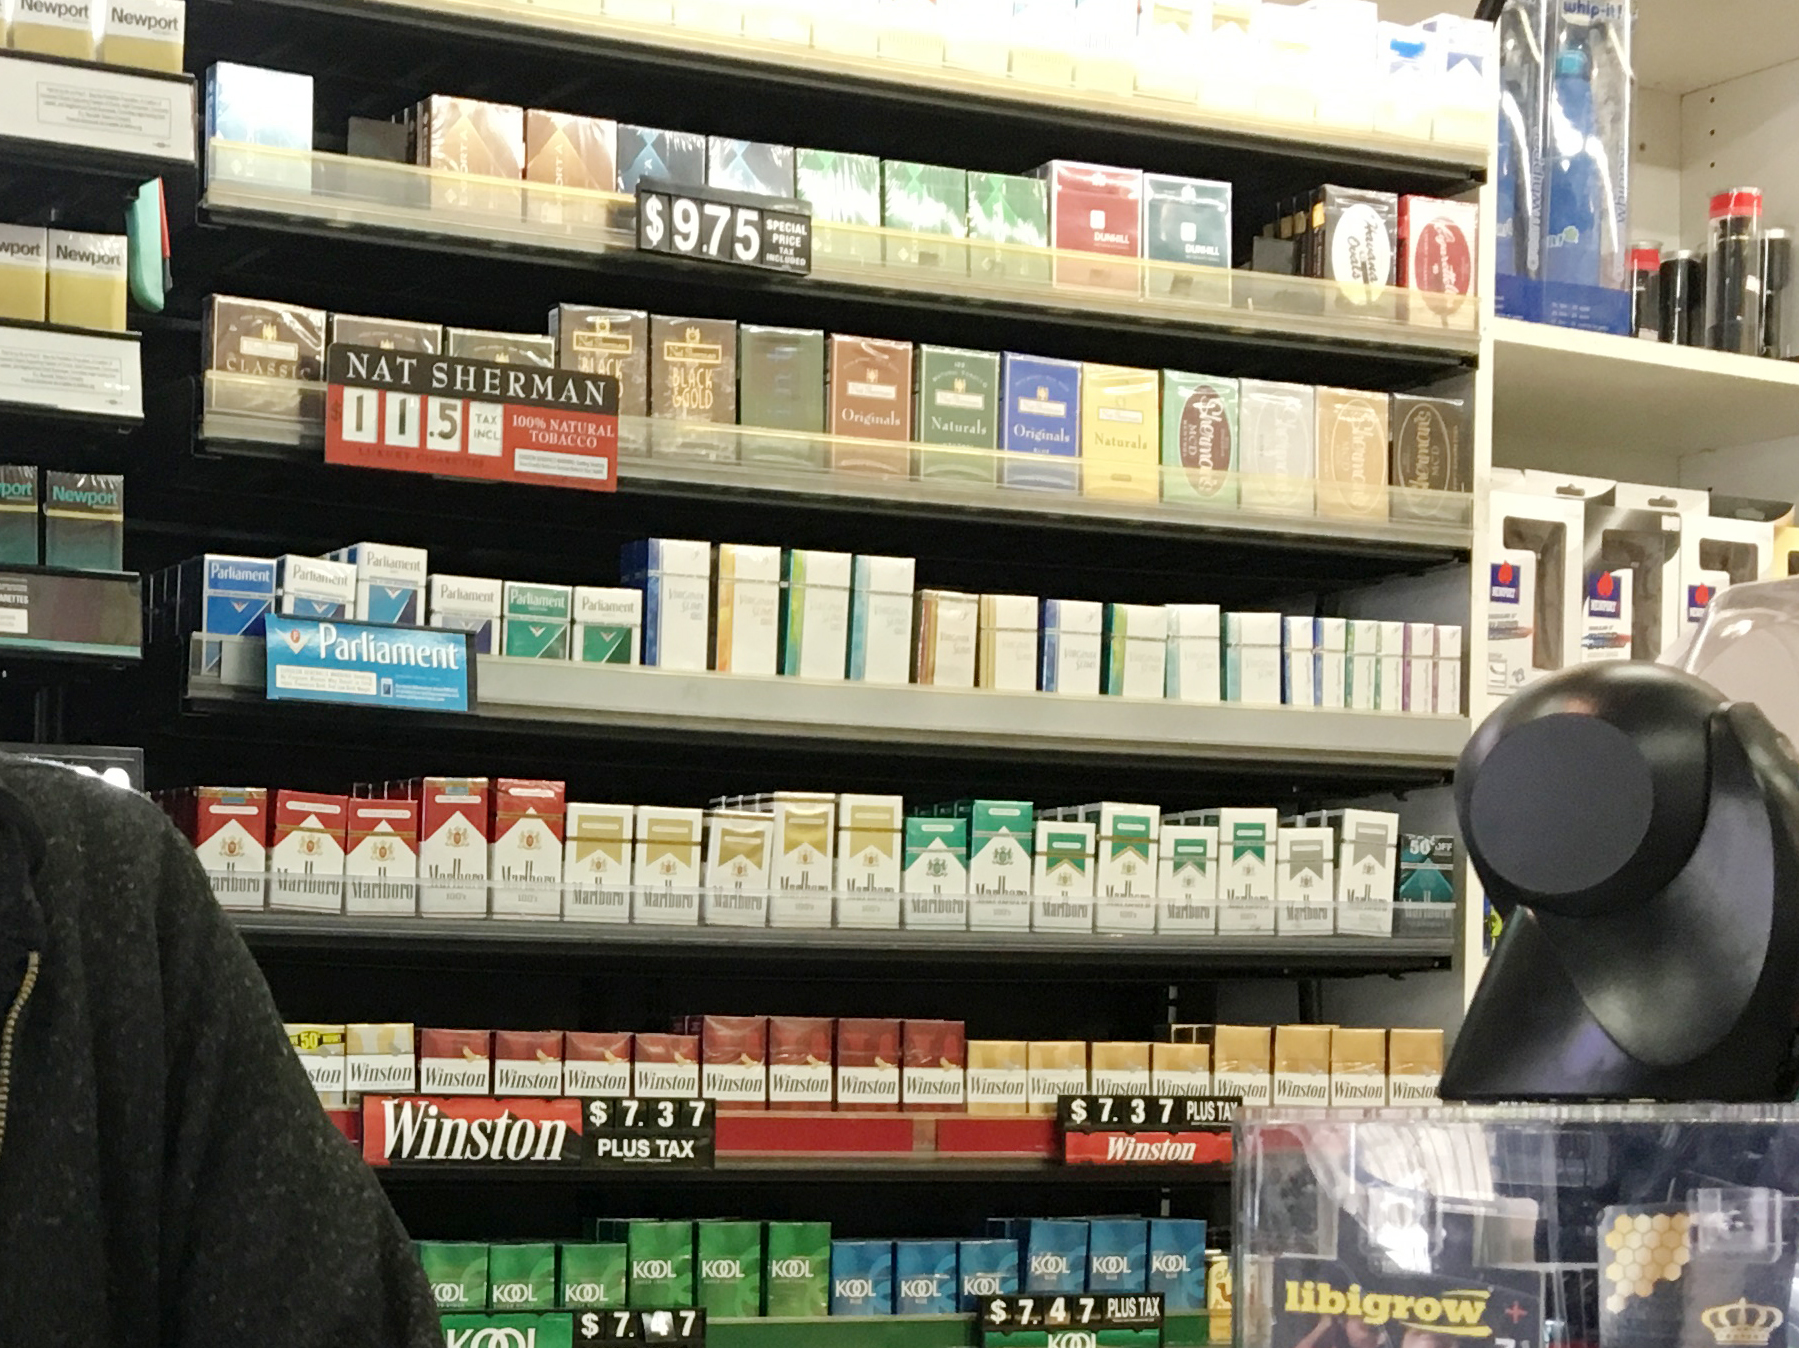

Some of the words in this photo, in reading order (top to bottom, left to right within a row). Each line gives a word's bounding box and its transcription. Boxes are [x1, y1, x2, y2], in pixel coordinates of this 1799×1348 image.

[766, 219, 807, 235] SPECIAL
[772, 233, 801, 247] PRICE
[766, 253, 806, 266] INCLUDED
[779, 247, 794, 256] TAX
[346, 351, 417, 385] NAT
[431, 362, 606, 406] SHERMAN
[512, 415, 546, 430] 100%
[550, 419, 614, 437] NATURAL
[931, 416, 987, 436] Naturals
[529, 429, 597, 448] TOBACCO
[210, 563, 271, 586] Parliament
[318, 623, 460, 672] Parliament
[351, 868, 414, 902] Marlboro
[349, 1062, 413, 1088] Winston
[772, 1073, 829, 1094] Winston
[382, 1098, 569, 1162] Winston
[597, 1137, 650, 1159] PLUS
[657, 1138, 695, 1159] TAX
[632, 1260, 677, 1279] KOOL
[835, 1279, 876, 1297] KOOL
[1285, 1281, 1492, 1336] libigrow
